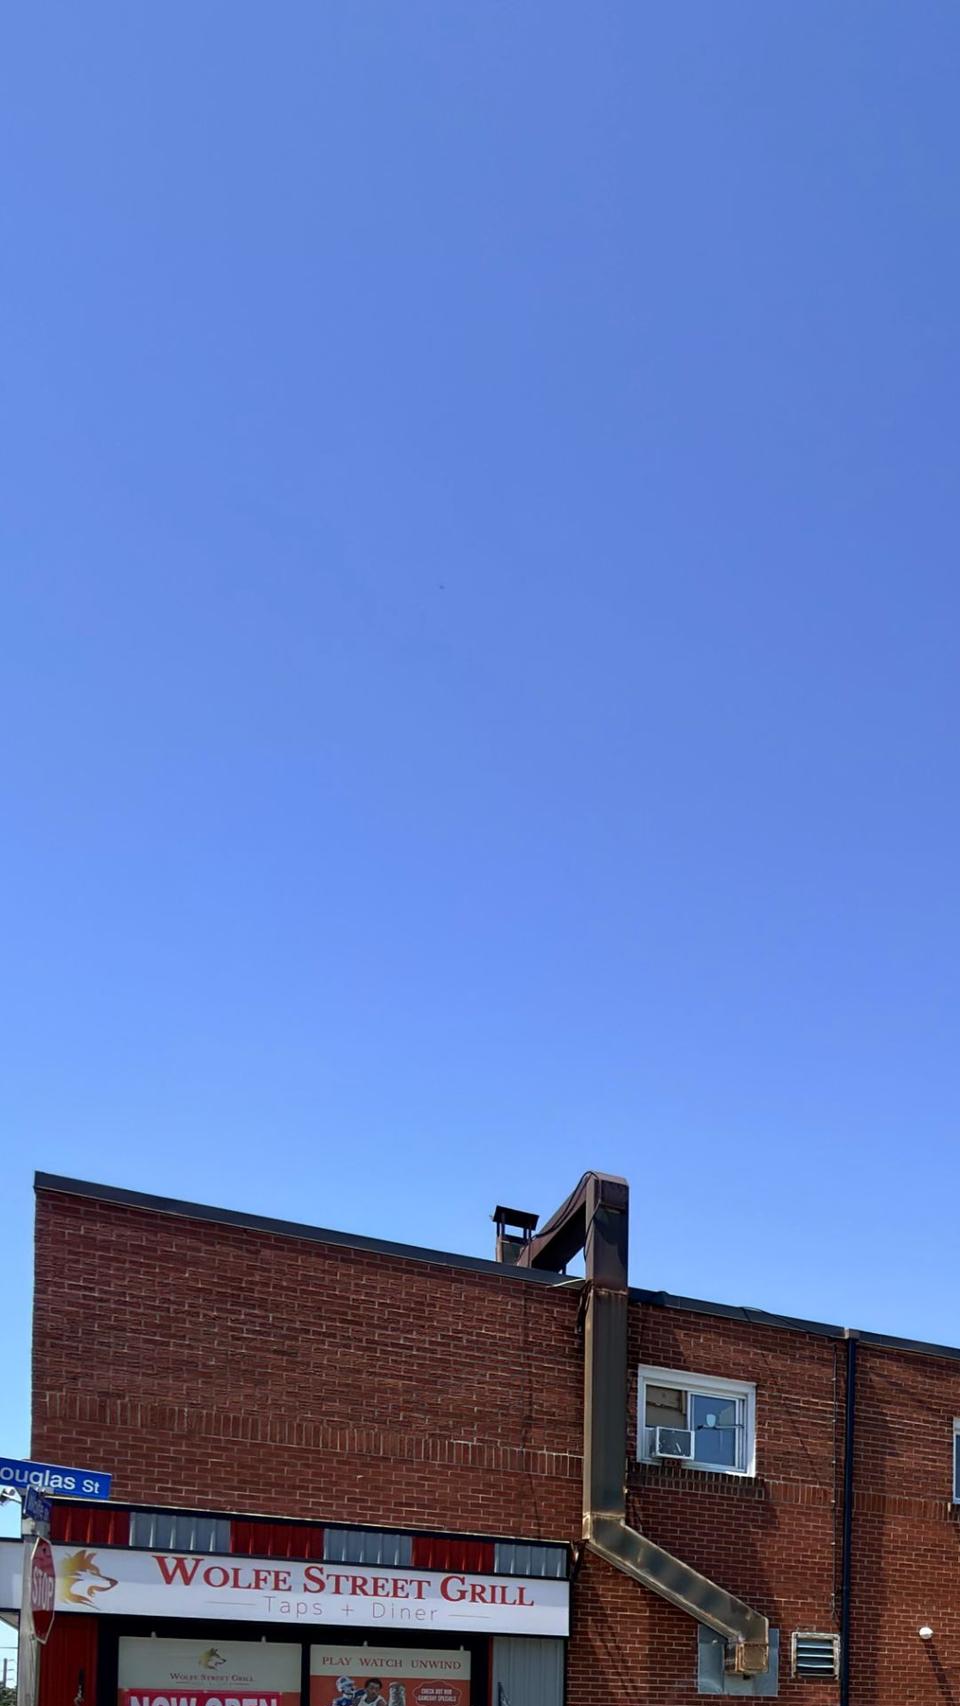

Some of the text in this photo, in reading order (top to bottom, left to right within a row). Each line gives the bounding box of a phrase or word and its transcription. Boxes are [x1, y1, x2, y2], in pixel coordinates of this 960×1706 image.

[0, 1466, 100, 1494] ouglas St
[32, 1566, 54, 1610] STOP
[152, 1555, 535, 1607] WOLFE STREET GRILL
[263, 1595, 323, 1619] Taps
[372, 1601, 438, 1622] Diner
[322, 1656, 462, 1671] PLAY WATCH UNWIND
